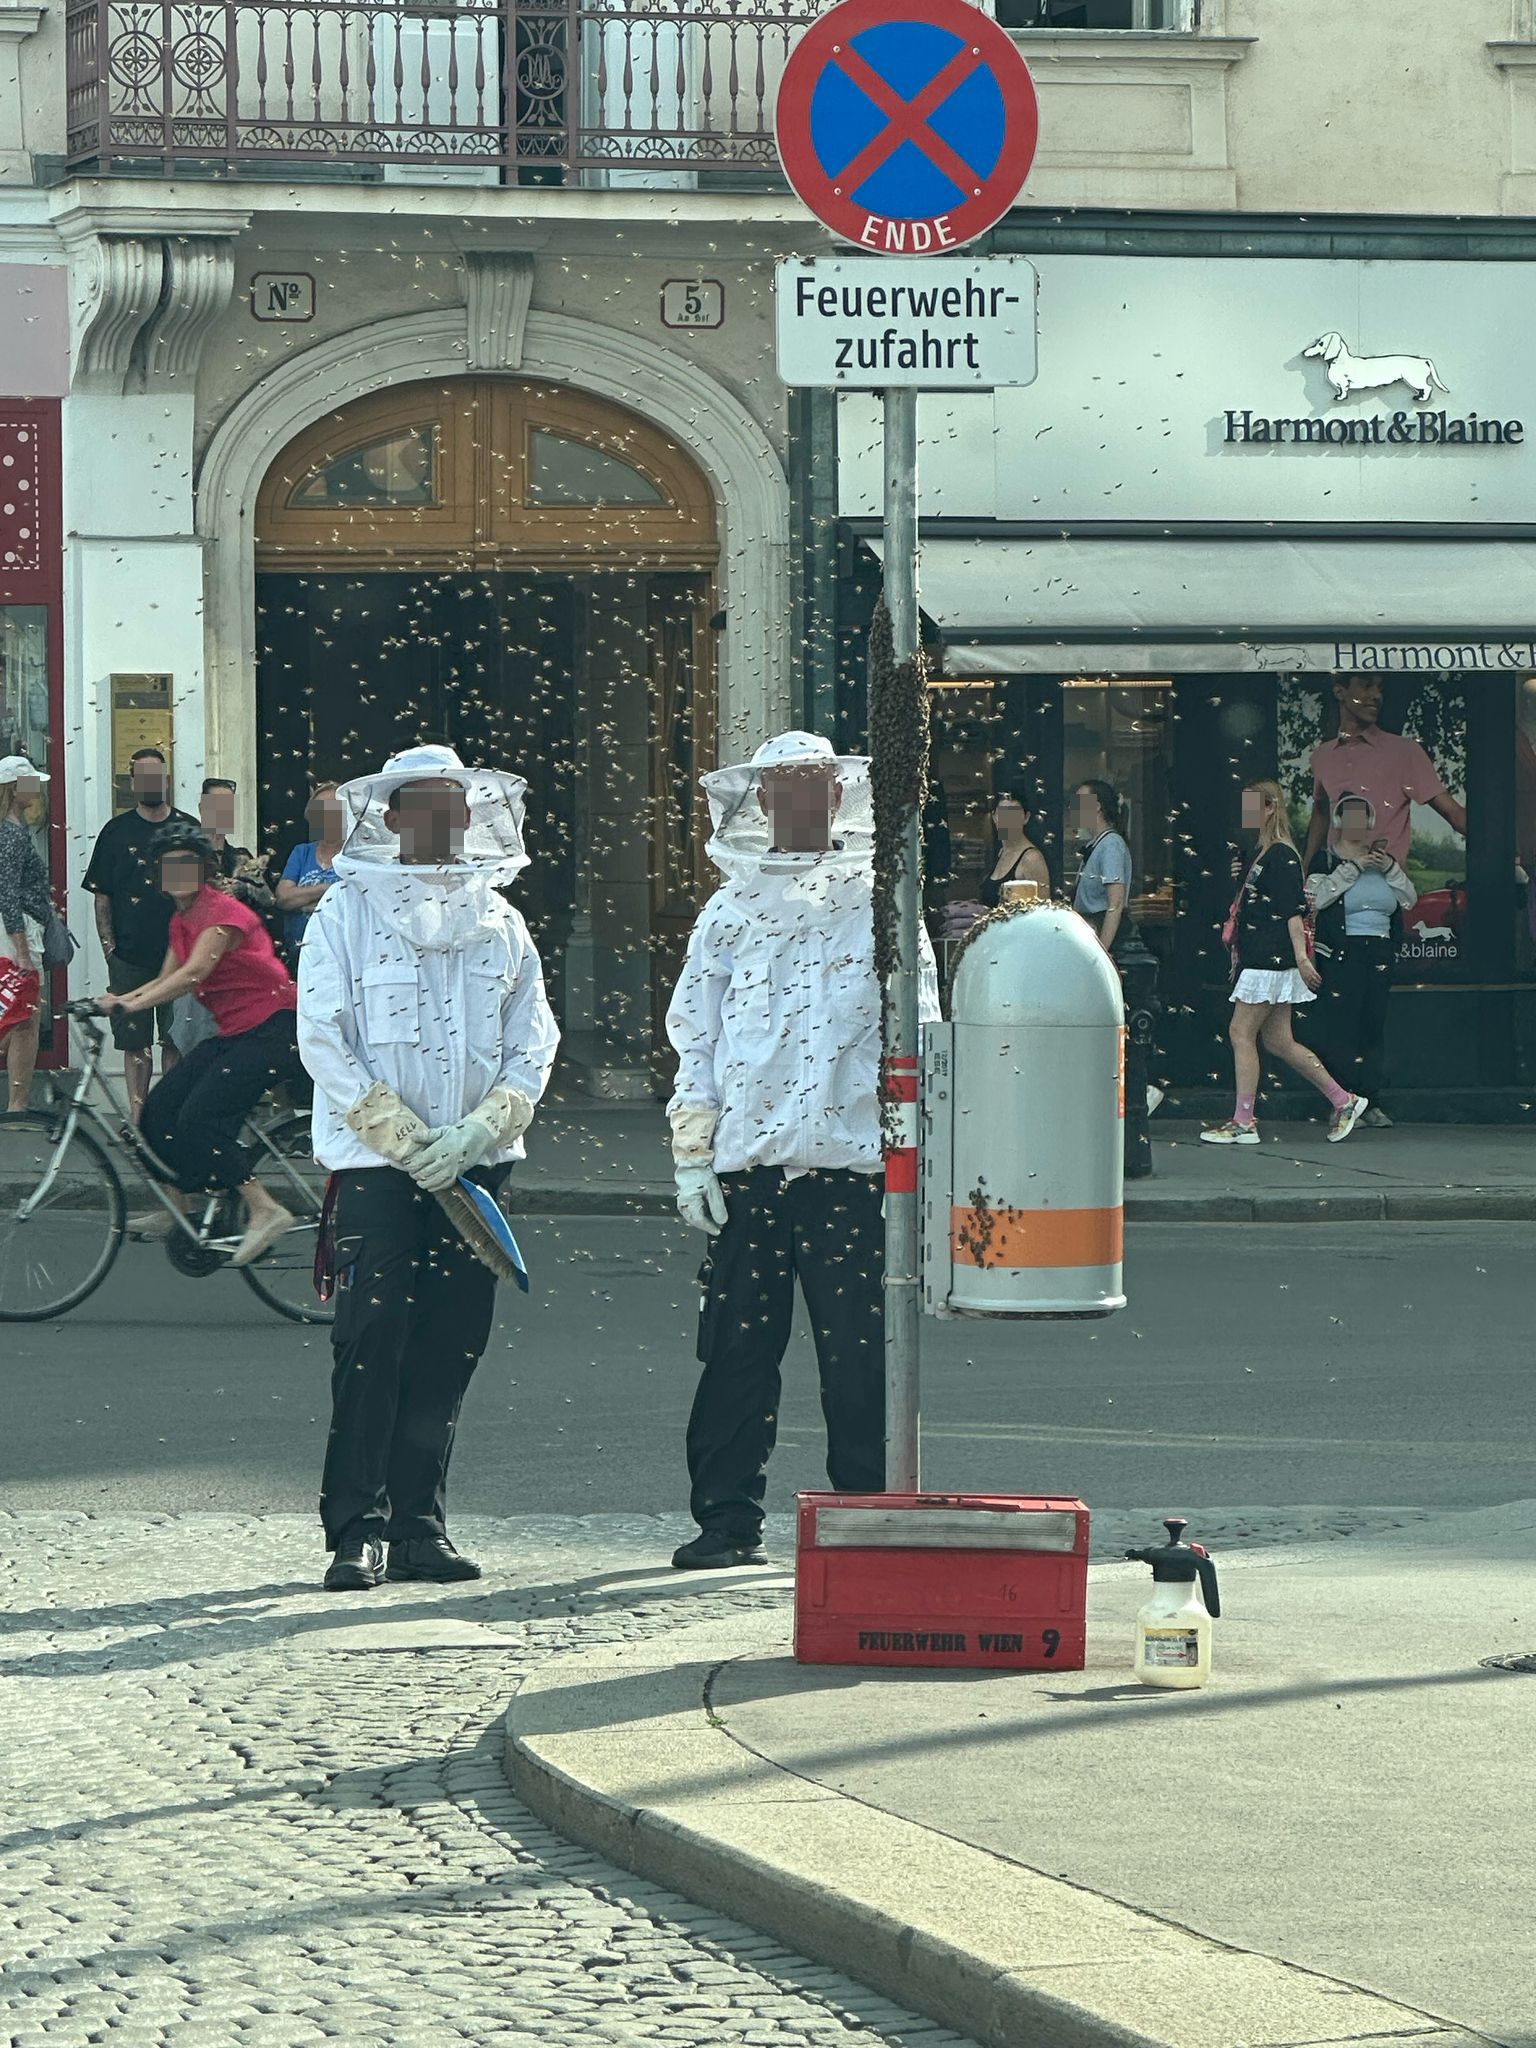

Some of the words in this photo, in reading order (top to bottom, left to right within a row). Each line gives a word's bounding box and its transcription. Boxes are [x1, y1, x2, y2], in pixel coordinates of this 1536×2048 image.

[860, 215, 957, 252] ENDE
[684, 285, 702, 315] 5
[796, 276, 1020, 318] Feuerwehr-
[834, 328, 981, 369] zufahrt
[1223, 410, 1524, 445] Harmont&Blaine
[1000, 1583, 1018, 1602] 16
[858, 1630, 967, 1653] FEUERWEHR
[978, 1632, 1024, 1654] WIEN
[1041, 1628, 1060, 1659] 9
